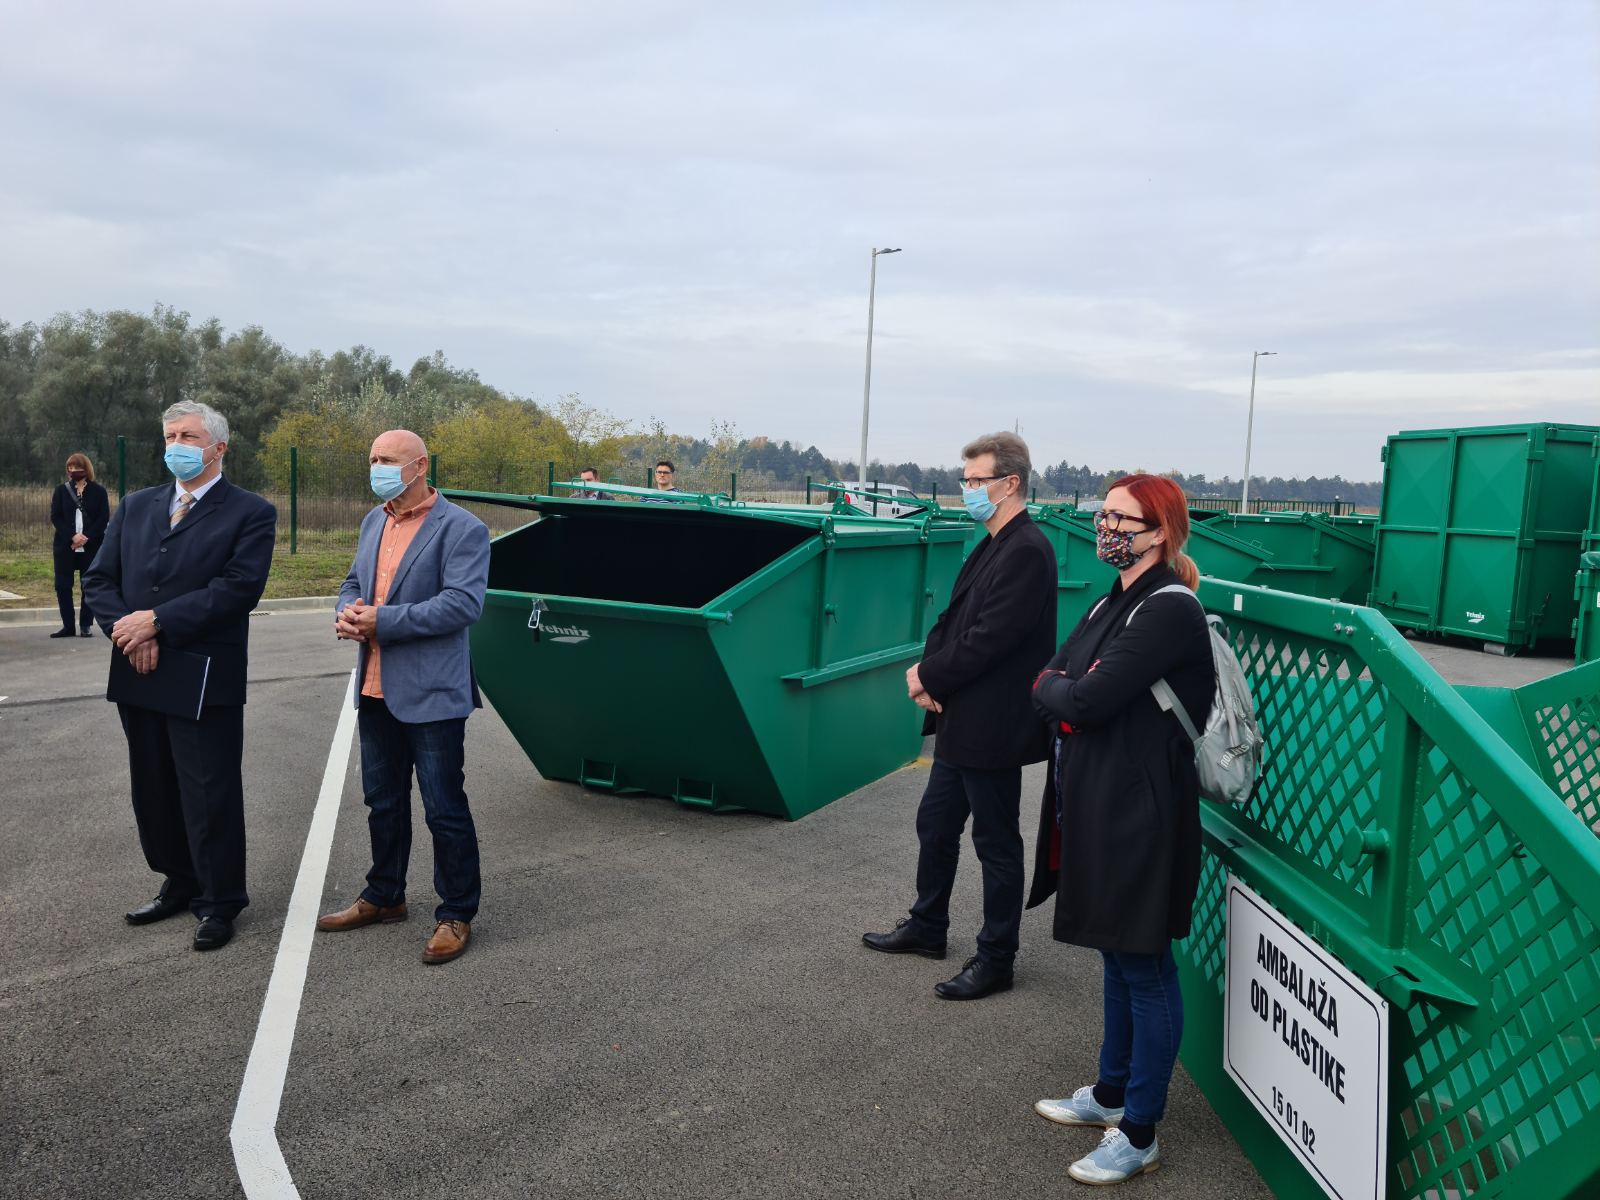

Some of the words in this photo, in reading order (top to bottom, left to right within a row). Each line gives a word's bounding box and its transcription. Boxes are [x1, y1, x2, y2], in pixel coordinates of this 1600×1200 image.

[1257, 933, 1339, 1038] AMBALAŽA
[1250, 978, 1269, 1022] OD
[1273, 998, 1346, 1105] PLASTIKE
[1272, 1086, 1283, 1116] 15
[1286, 1102, 1298, 1135] 01
[1302, 1120, 1316, 1155] 02
